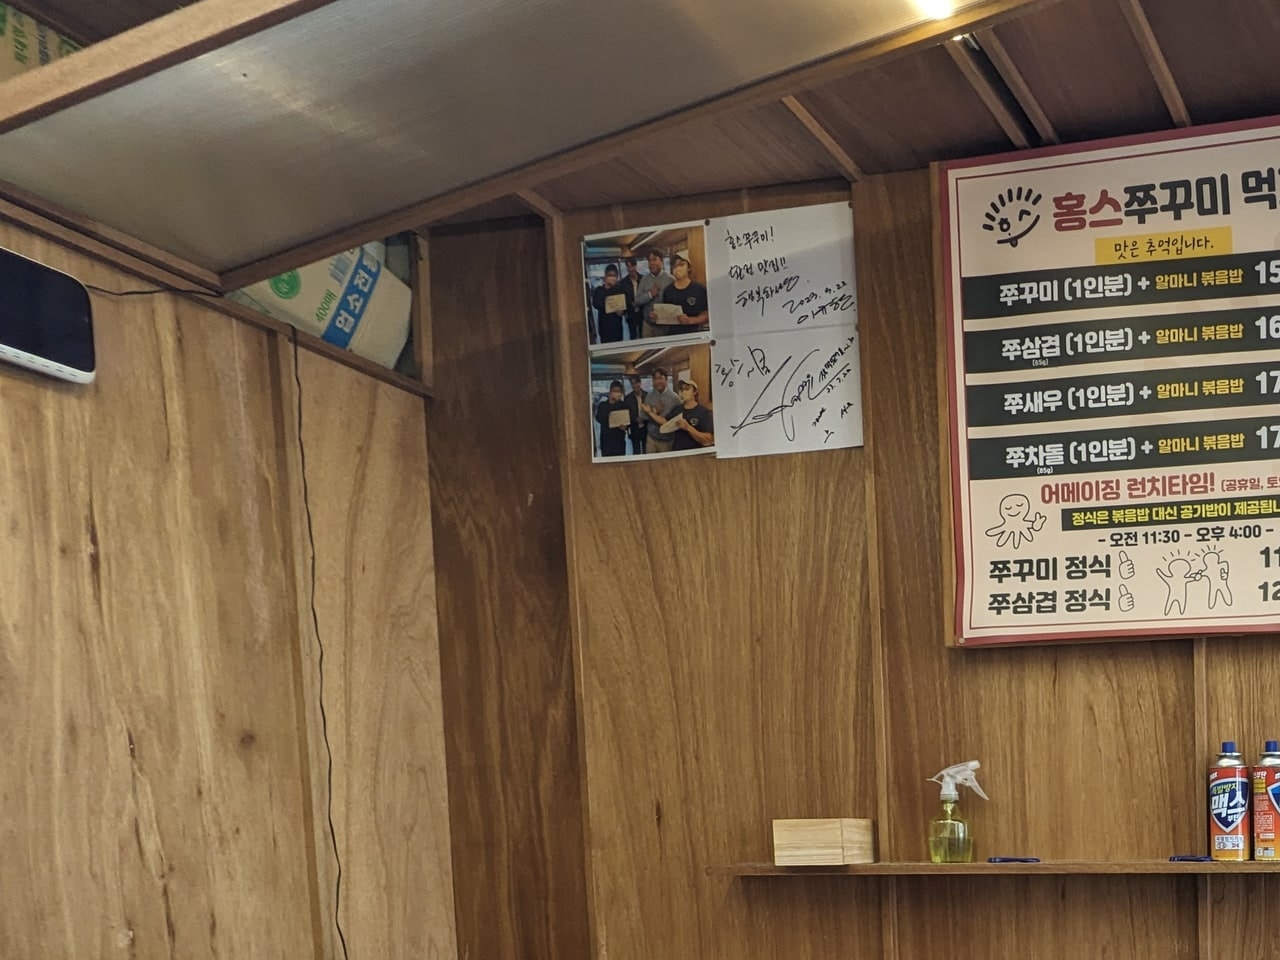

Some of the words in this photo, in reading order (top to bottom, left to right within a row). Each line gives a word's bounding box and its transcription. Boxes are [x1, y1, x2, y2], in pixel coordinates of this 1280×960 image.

[1052, 173, 1232, 233] 홍스쭈꾸미
[1114, 239, 1139, 260] 맛은
[1145, 236, 1215, 256] 추억입니다.
[999, 280, 1059, 307] 쭈꾸미
[1064, 273, 1132, 301] (1인분)
[1155, 272, 1198, 290] 알마니
[1201, 268, 1243, 287] 볶음밥
[1001, 334, 1061, 361] 쭈삼겹
[1065, 327, 1133, 356] (1인분)
[1155, 327, 1198, 345] 알마니
[1201, 323, 1243, 342] 볶음밥
[1003, 391, 1063, 415] 쭈새우
[1068, 383, 1134, 410] (1인분)
[1156, 382, 1198, 400] 알마니
[1202, 378, 1244, 395] 볶음밥
[1005, 444, 1064, 468] 쭈차돌
[1069, 437, 1136, 465] (1인분)
[1158, 436, 1199, 454] 알마니
[1203, 433, 1245, 450] 볶음밥
[1040, 479, 1121, 505] 어메이징
[1126, 473, 1215, 500] 런치타임!
[1221, 479, 1264, 492] (공휴일,
[1072, 511, 1109, 526] 정식은
[1112, 508, 1149, 524] 볶음밥
[1153, 506, 1177, 522] 대신
[1180, 503, 1231, 519] 공기밥이
[1110, 531, 1138, 548] 오전
[1142, 529, 1180, 545] 11:30
[1196, 527, 1225, 543] 오후
[1229, 524, 1262, 540] 4:00
[989, 558, 1058, 583] 쭈꾸미
[1065, 554, 1111, 581] 정식
[988, 592, 1057, 616] 쭈삼겹
[1064, 588, 1111, 613] 정식
[1212, 791, 1245, 818] 맥스
